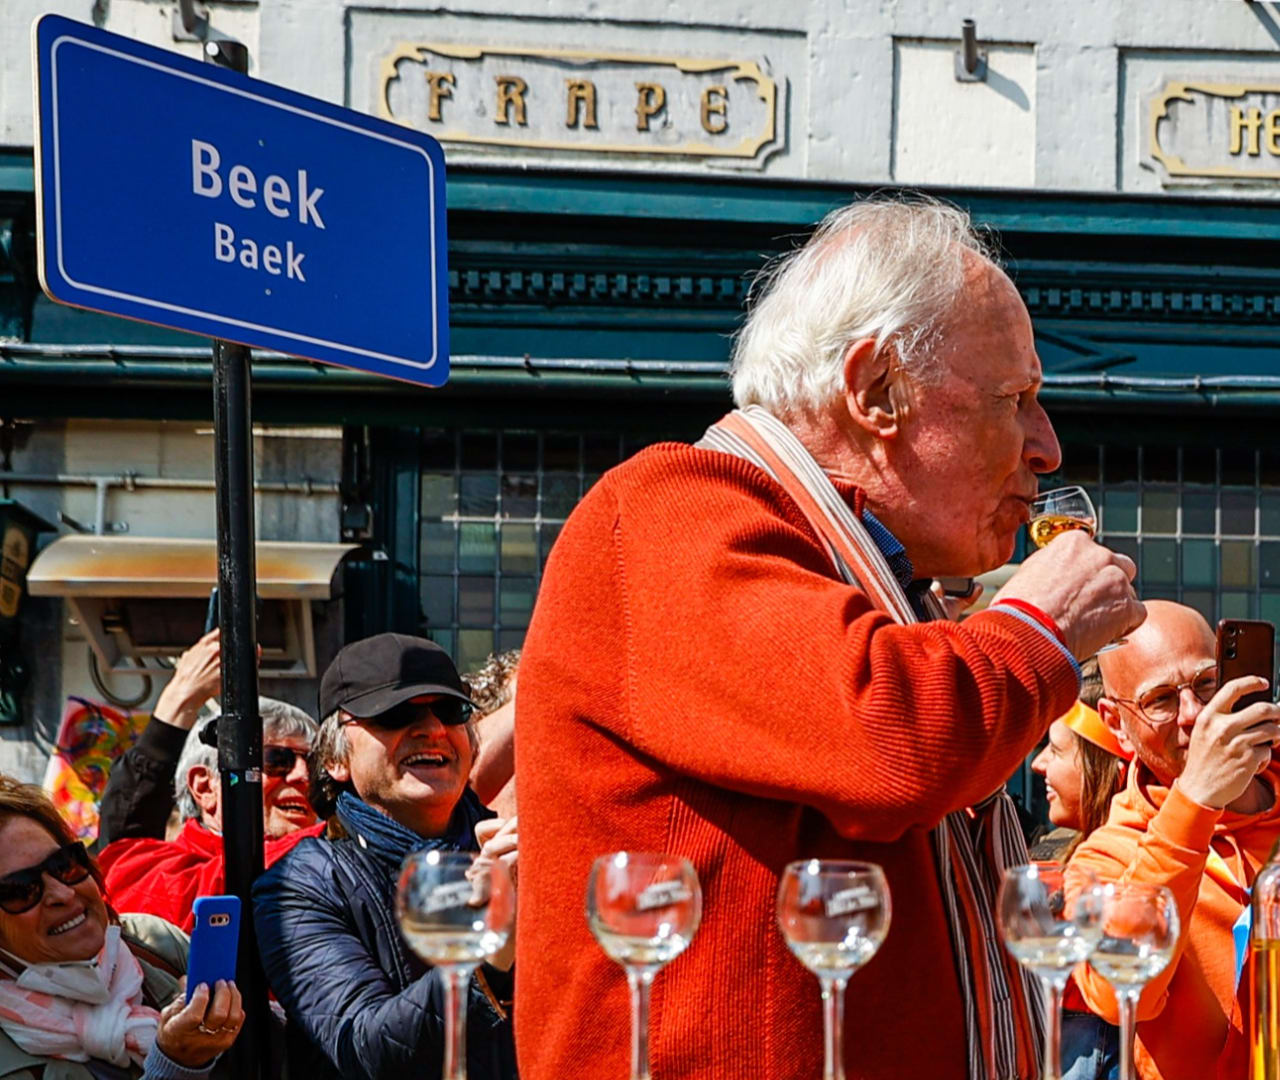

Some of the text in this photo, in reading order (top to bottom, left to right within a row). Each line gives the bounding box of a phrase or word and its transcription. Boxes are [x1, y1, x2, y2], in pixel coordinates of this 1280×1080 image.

[424, 71, 730, 135] FRAPE
[191, 139, 325, 229] Beek
[214, 222, 306, 282] Baek
